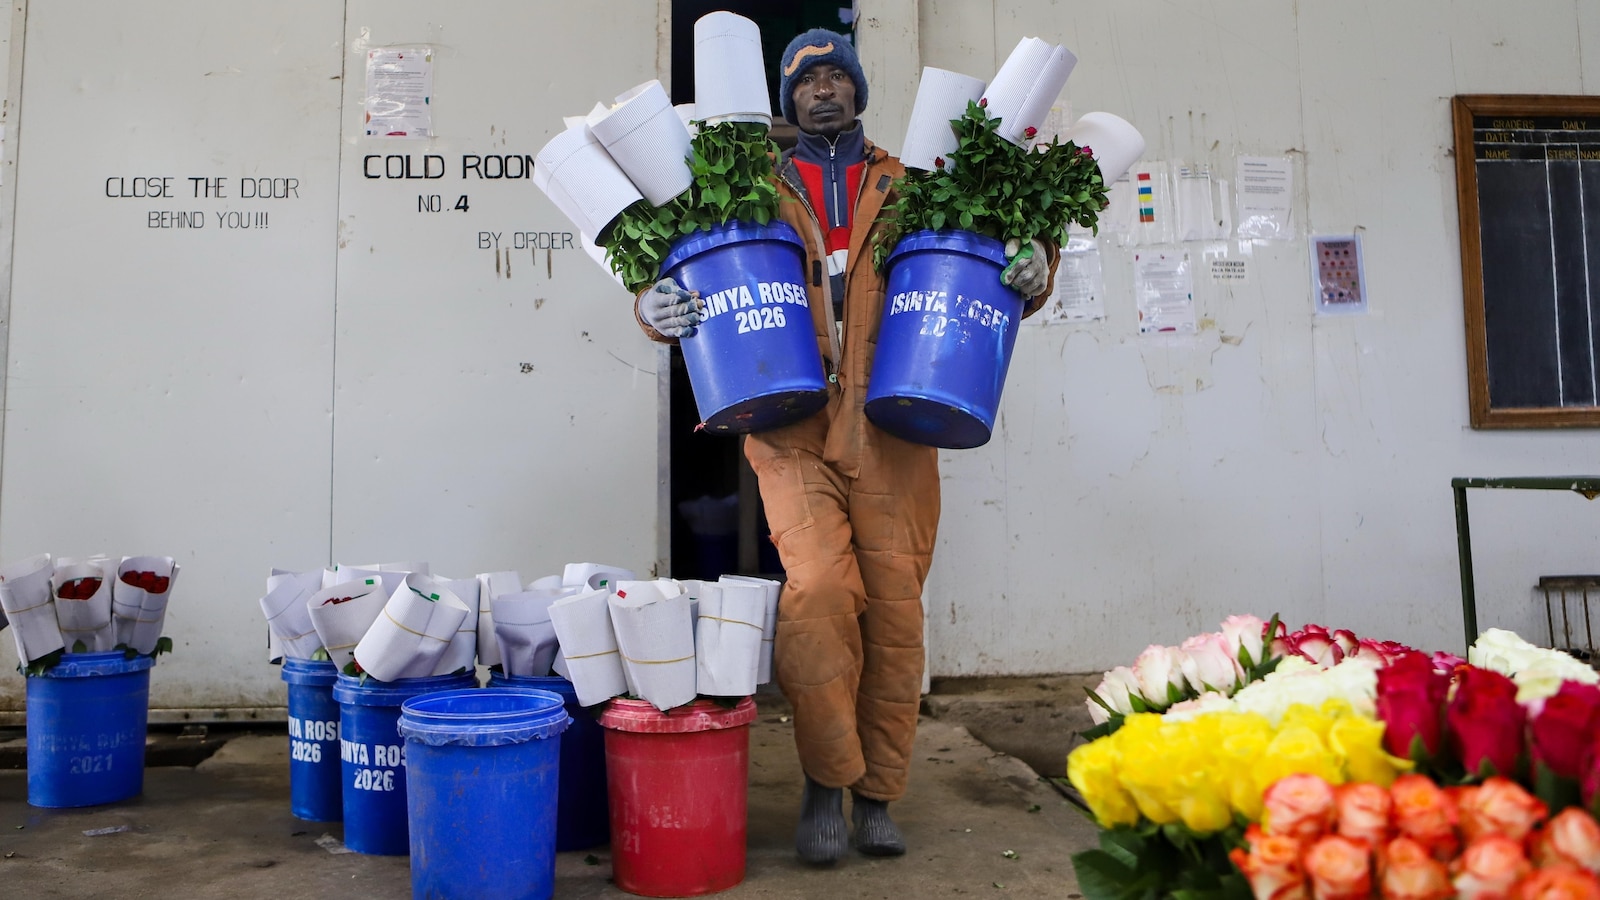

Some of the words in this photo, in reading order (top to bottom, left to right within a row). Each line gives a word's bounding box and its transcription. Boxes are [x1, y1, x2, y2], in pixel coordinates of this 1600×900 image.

[1562, 121, 1587, 131] DAILY
[1485, 150, 1510, 159] NAME
[1547, 150, 1577, 160] STEMS
[363, 155, 446, 179] COLD
[106, 177, 175, 198] CLOSE
[188, 177, 228, 198] THE
[241, 177, 300, 199] DOOR
[148, 211, 205, 229] BEHIND
[216, 211, 269, 229] YOU!!!
[478, 231, 502, 249] BY
[758, 282, 808, 308] ROSES
[890, 290, 947, 316] ISINYA
[735, 306, 786, 335] 2026
[292, 740, 321, 763] 2026
[70, 754, 113, 774] 2021
[353, 768, 395, 791] 2026
